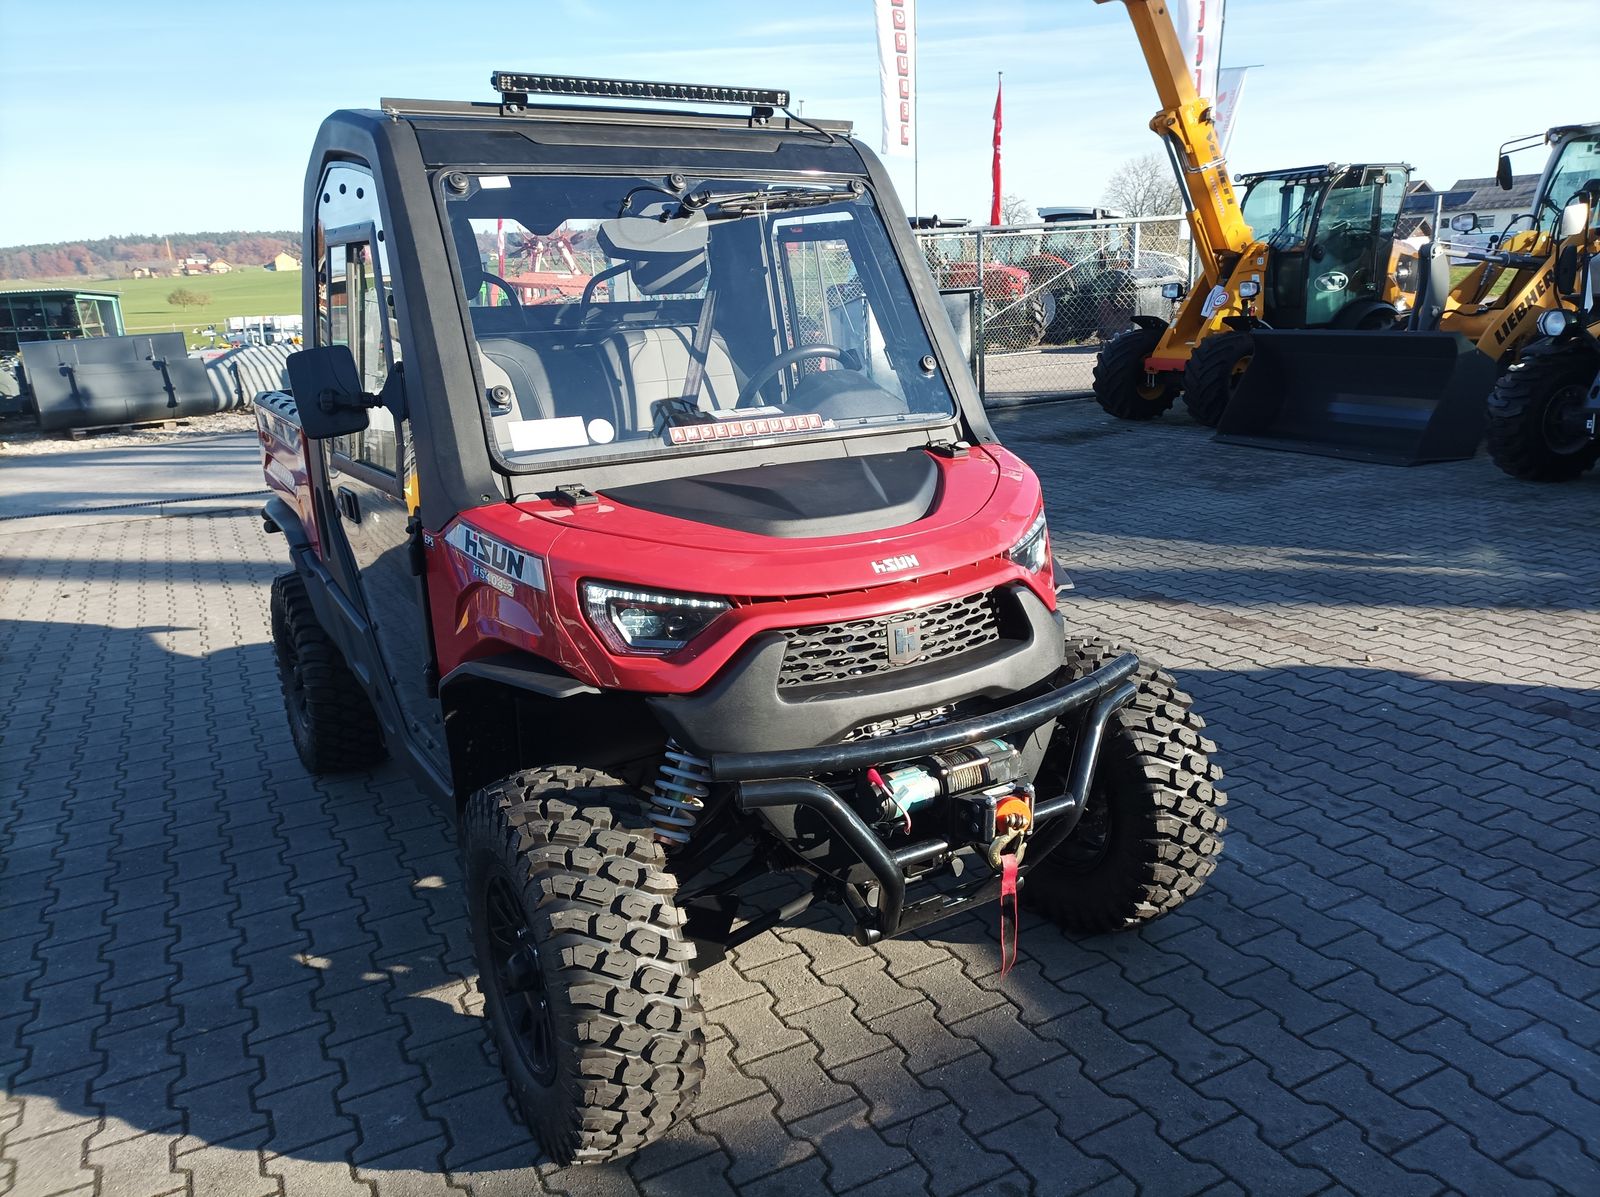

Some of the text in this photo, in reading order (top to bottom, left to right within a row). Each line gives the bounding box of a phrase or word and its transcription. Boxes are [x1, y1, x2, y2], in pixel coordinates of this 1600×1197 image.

[1494, 269, 1555, 345] LIEBHER
[423, 534, 434, 547] EPS
[465, 529, 525, 579] HSUN
[871, 554, 920, 574] HSUN
